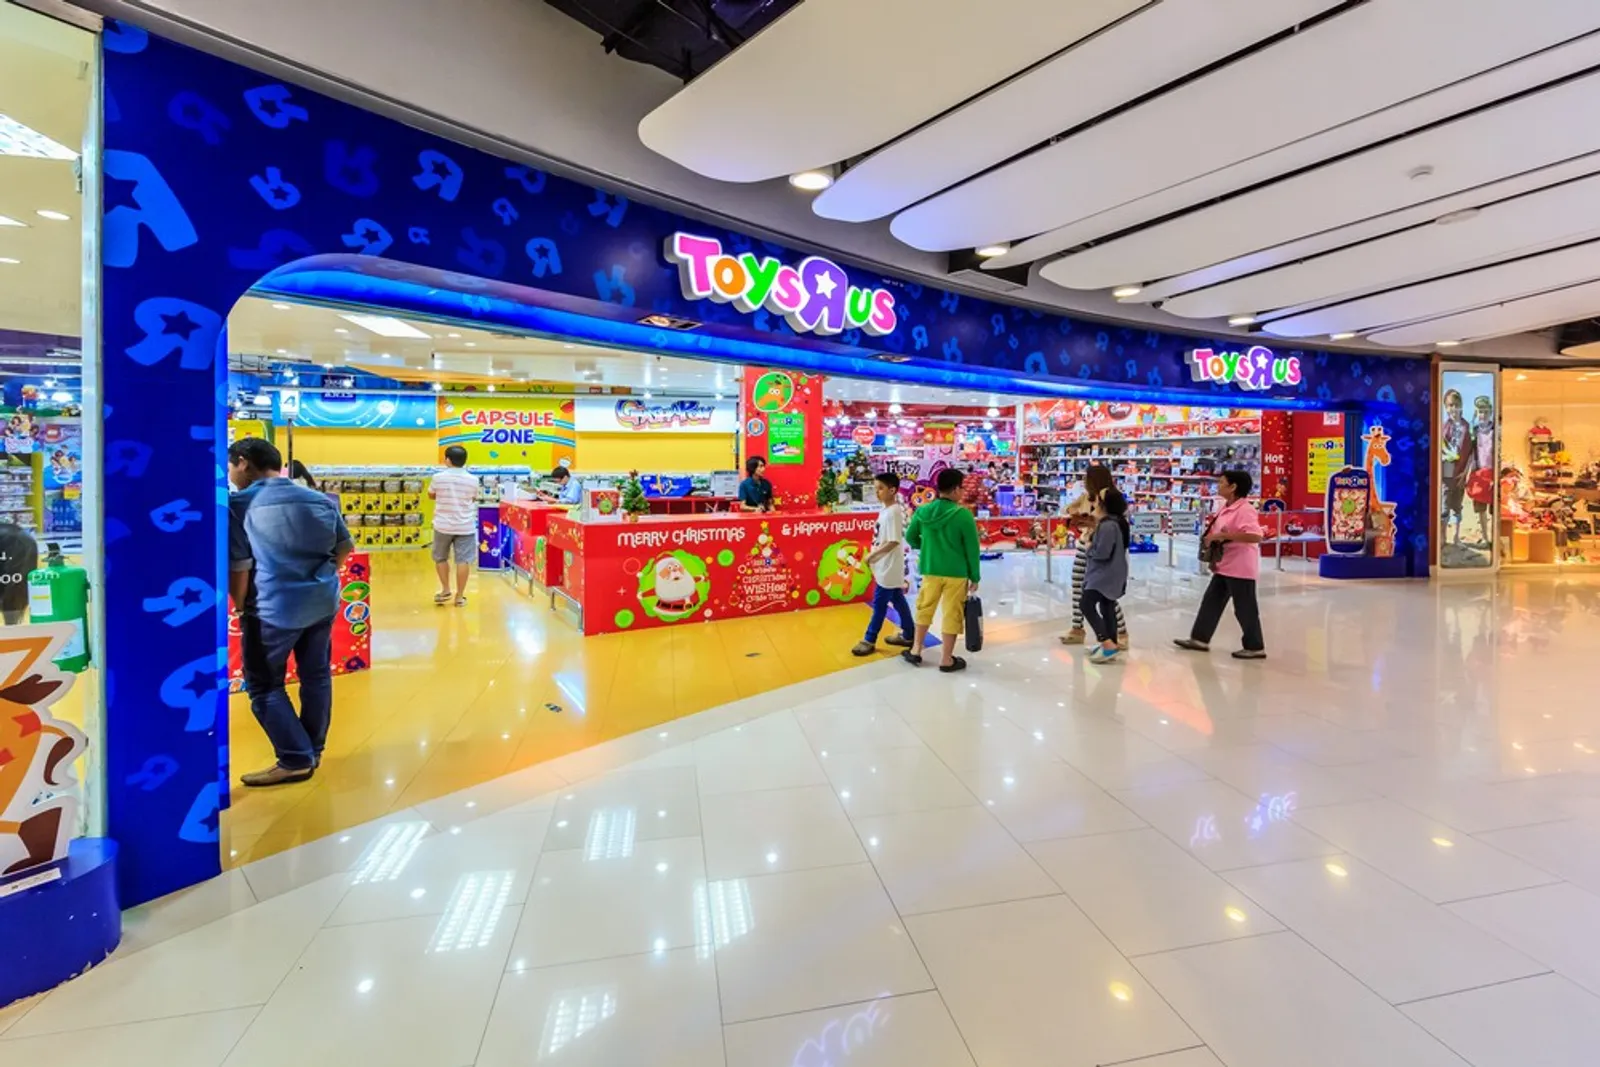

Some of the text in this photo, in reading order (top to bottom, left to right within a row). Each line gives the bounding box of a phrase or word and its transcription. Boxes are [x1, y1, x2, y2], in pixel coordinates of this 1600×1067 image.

[460, 409, 555, 427] CAPSULE
[480, 428, 535, 445] ZONE
[1264, 453, 1284, 464] Hot
[617, 526, 746, 548] MERRY CHRISTMAS
[781, 524, 791, 536] &
[792, 522, 829, 537] HAPPY
